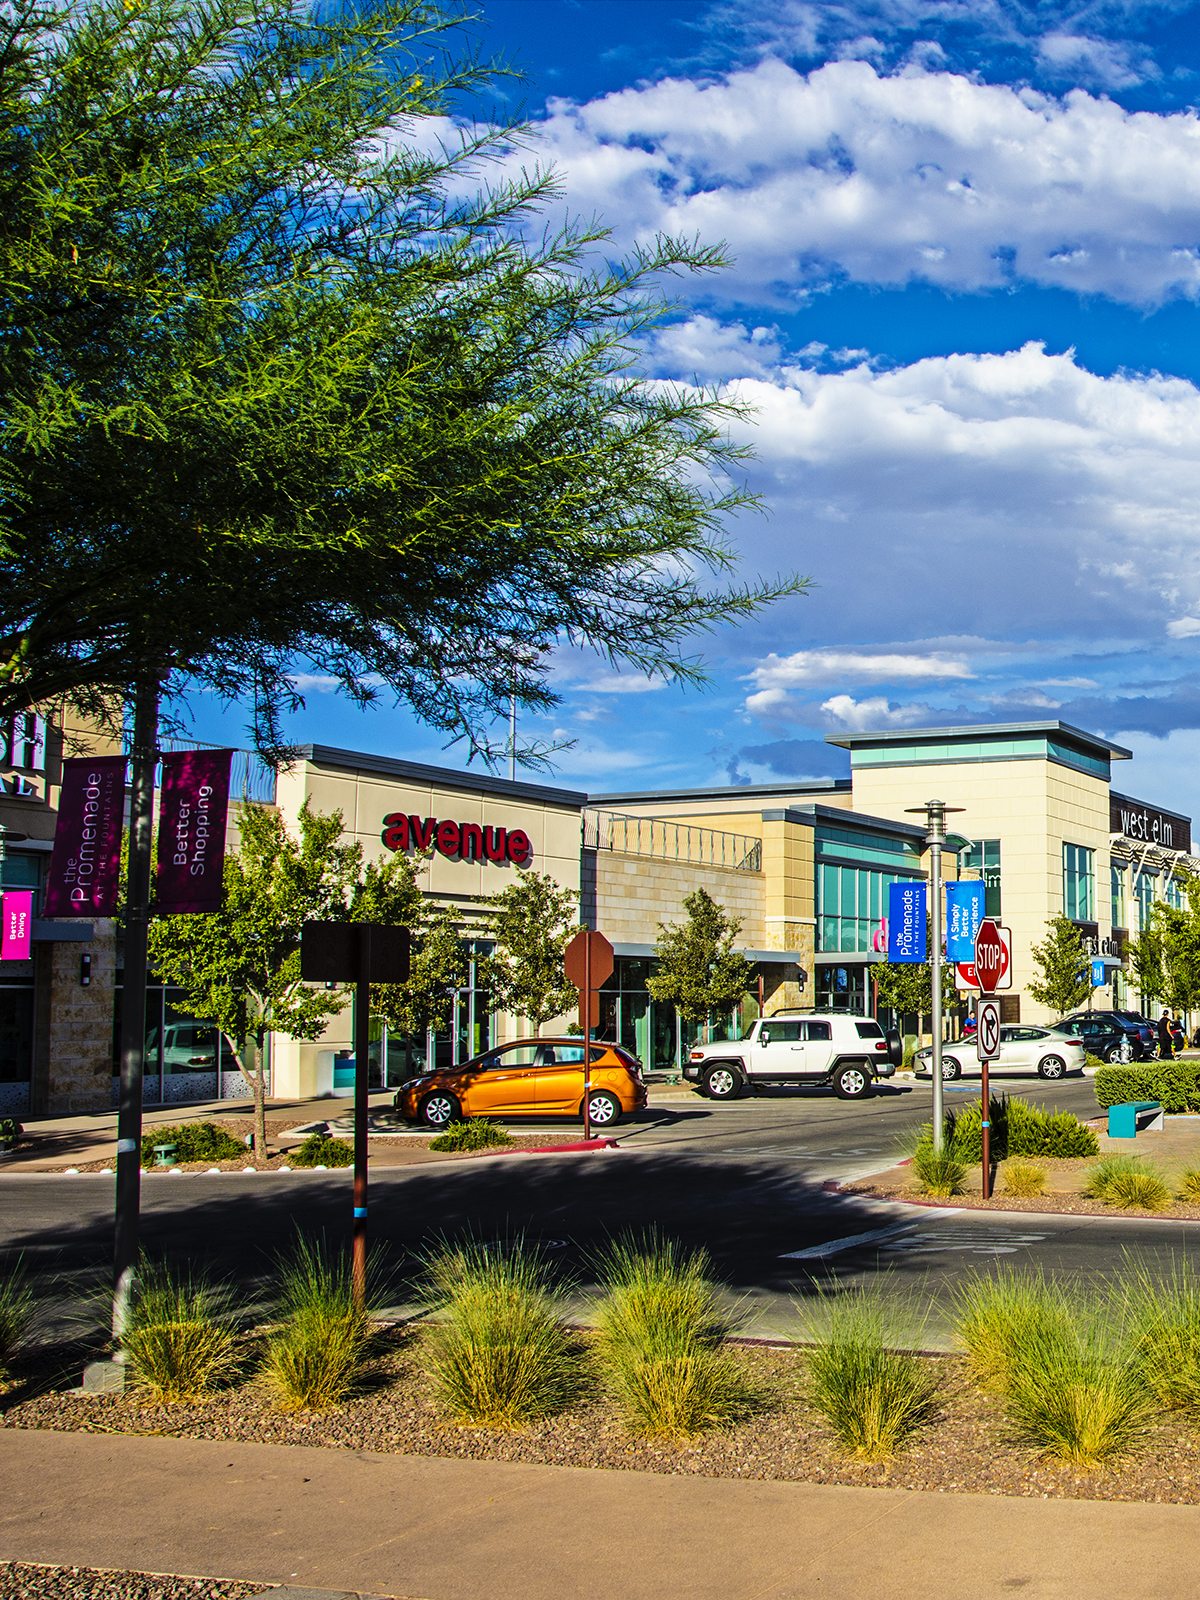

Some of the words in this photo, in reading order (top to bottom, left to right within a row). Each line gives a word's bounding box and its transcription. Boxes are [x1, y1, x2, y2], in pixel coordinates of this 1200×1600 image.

[100, 772, 114, 847] FOUNTAINS
[70, 773, 101, 902] Promenade
[173, 798, 190, 865] Better
[190, 785, 213, 875] Shopping
[382, 812, 530, 864] avenue
[1121, 810, 1148, 840] west
[1152, 815, 1172, 846] elm
[64, 858, 78, 883] the
[97, 886, 105, 899] AT
[9, 911, 17, 940] Better
[17, 912, 27, 938] Dining
[901, 890, 913, 955] Promenade
[951, 903, 961, 933] Simply
[961, 907, 969, 937] Better
[896, 933, 904, 946] the
[915, 946, 919, 954] AT
[977, 943, 1000, 970] STOP
